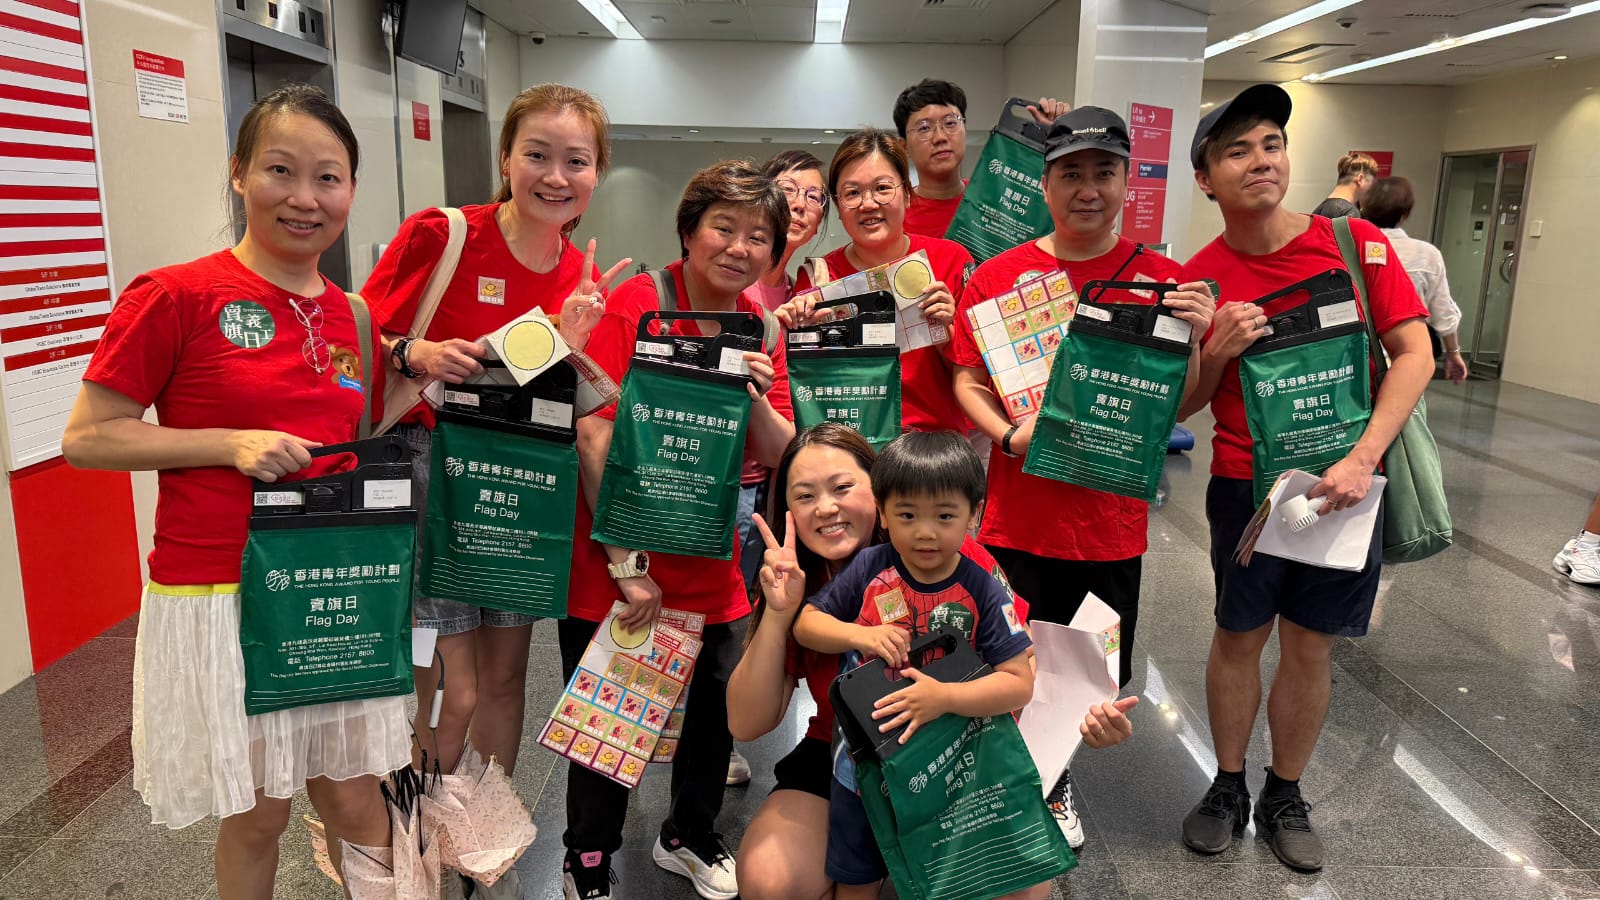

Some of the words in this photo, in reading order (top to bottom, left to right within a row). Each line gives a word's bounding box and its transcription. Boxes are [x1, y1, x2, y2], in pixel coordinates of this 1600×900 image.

[1131, 130, 1135, 139] 2
[1000, 197, 1013, 210] Flag
[1013, 204, 1027, 216] Day
[1096, 393, 1132, 411] 賣旗日
[1293, 394, 1330, 410] 賣旗日
[827, 408, 859, 418] 賣旗日
[1090, 405, 1108, 419] Flag
[1111, 411, 1130, 424] Day
[1292, 412, 1313, 421] Flag
[1316, 408, 1334, 417] Day
[662, 434, 700, 451] 賣旗日
[657, 449, 678, 462] Flag
[681, 453, 700, 464] Day
[479, 488, 519, 506] 賣旗日
[474, 504, 497, 517] Flag
[500, 508, 520, 520] Day
[310, 595, 357, 612] 賣旗日
[305, 616, 331, 627] Flag
[336, 614, 360, 625] Day
[306, 653, 338, 663] Telephone
[340, 652, 355, 660] 2157
